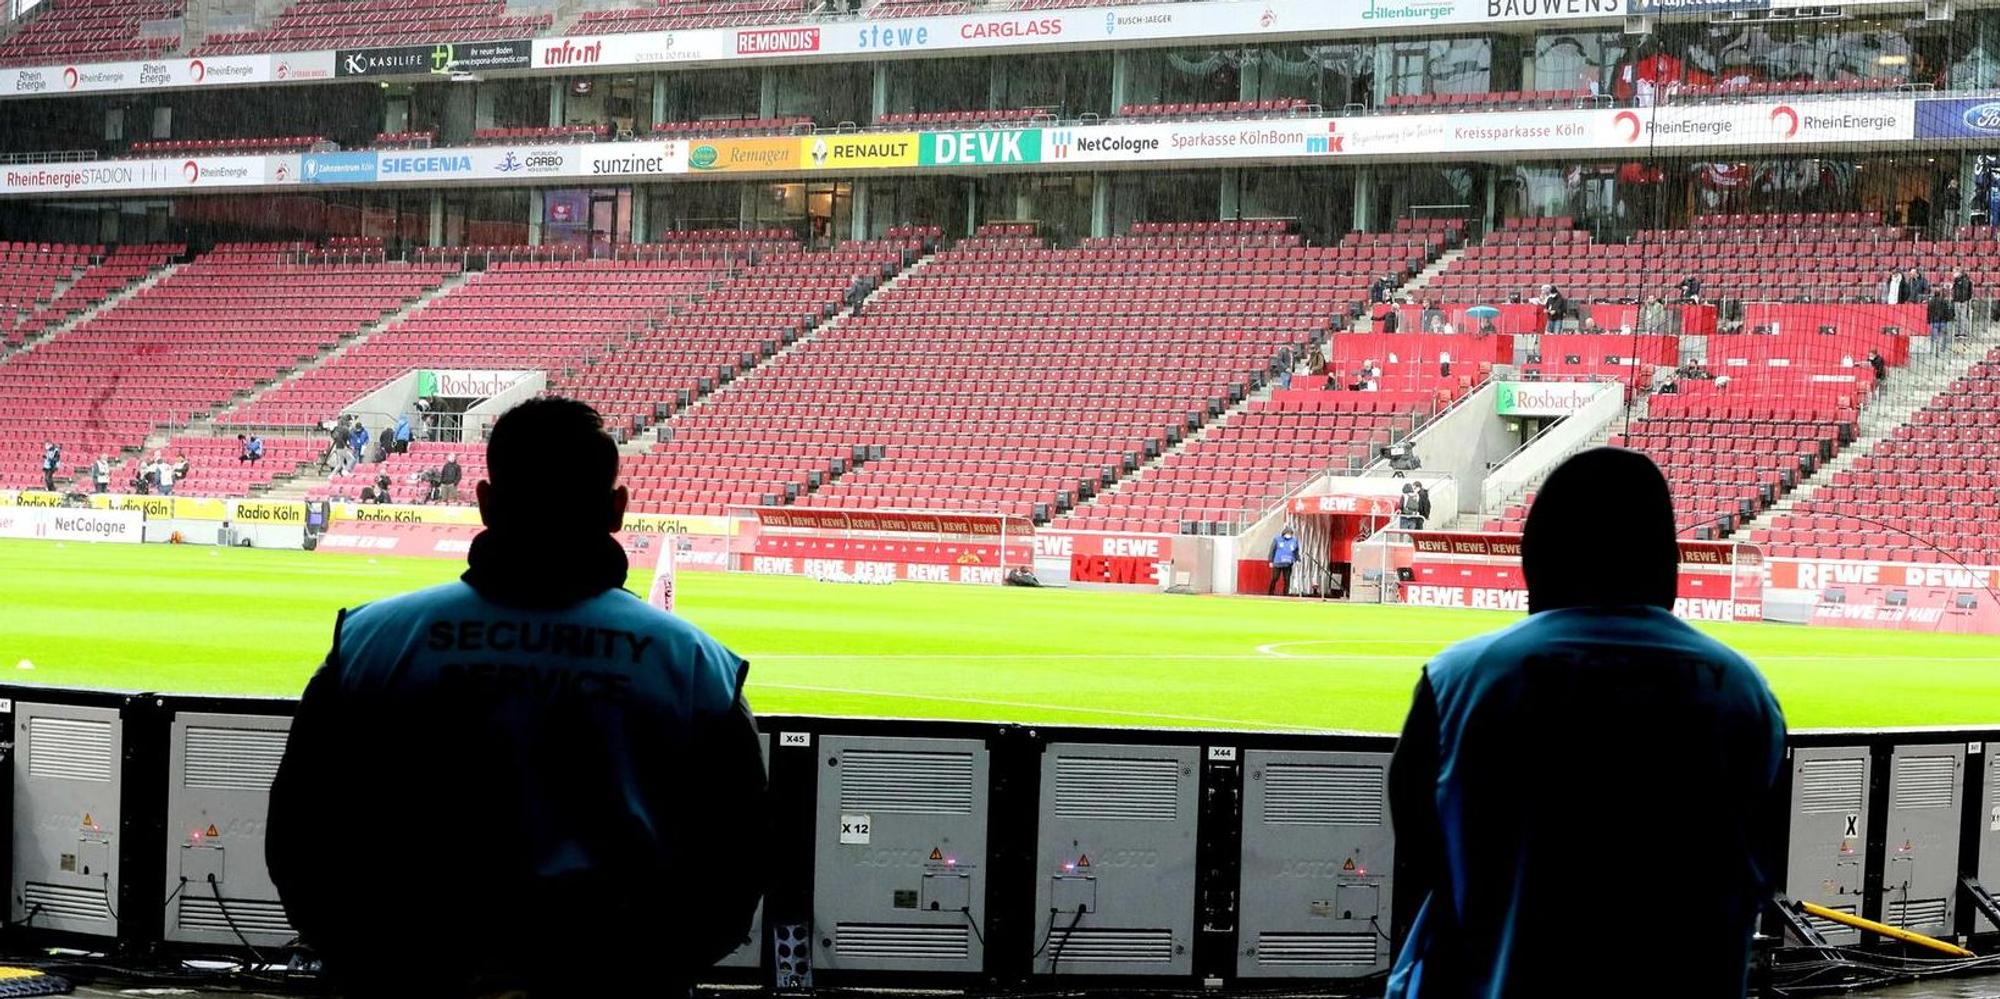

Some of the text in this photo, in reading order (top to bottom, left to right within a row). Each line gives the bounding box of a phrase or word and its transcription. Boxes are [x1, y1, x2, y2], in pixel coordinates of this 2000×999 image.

[1362, 0, 1455, 20] dillenburger
[858, 25, 928, 47] stewe
[960, 19, 1062, 39] CARGLASS
[738, 30, 814, 52] REMONDIS
[369, 54, 423, 67] KASILIFE
[20, 70, 42, 81] Rhein
[143, 63, 167, 75] Rhein
[17, 79, 46, 92] Energie
[140, 72, 172, 86] Energie
[1645, 119, 1732, 136] RheinEnergie
[1803, 114, 1897, 131] RheinEnergie
[1171, 129, 1304, 149] Sparkasse KölnBonn
[1454, 123, 1585, 141] Kreissparkasse Köln
[834, 142, 908, 158] RENAULT
[934, 132, 1024, 164] DEVK
[1077, 136, 1159, 154] NetCologne
[525, 155, 563, 167] CARBO
[730, 145, 789, 166] Remagen
[381, 156, 472, 173] SIEGENIA
[593, 154, 663, 174] sunzinet
[1319, 496, 1357, 511] REWE
[237, 504, 299, 521] Radio Köln
[357, 509, 422, 523] Radio Köln
[763, 514, 788, 526] REWE
[55, 517, 126, 536] NetCologne
[623, 520, 654, 532] adio
[792, 516, 817, 527] REWE
[821, 517, 846, 527] REWE
[852, 518, 877, 528] REWE
[881, 519, 906, 530] REWE
[910, 521, 937, 531] REWE
[942, 522, 969, 532] REWE
[972, 522, 999, 534] REWE
[1034, 535, 1074, 556] EWE
[1102, 537, 1160, 557] REWE
[1418, 540, 1449, 552] REWE
[1455, 542, 1486, 554] REWE
[1491, 543, 1522, 555] REWE
[1686, 551, 1718, 562] REWE
[905, 564, 951, 581] REWE
[1070, 554, 1160, 585] REWE
[1797, 562, 1880, 590] REWE
[1406, 585, 1465, 606] REWE
[1470, 587, 1529, 609] REWE
[428, 620, 653, 664] SECURITY
[786, 735, 805, 743] X45
[1213, 749, 1231, 757] X44
[842, 824, 869, 833] X 12
[1845, 816, 1857, 835] X
